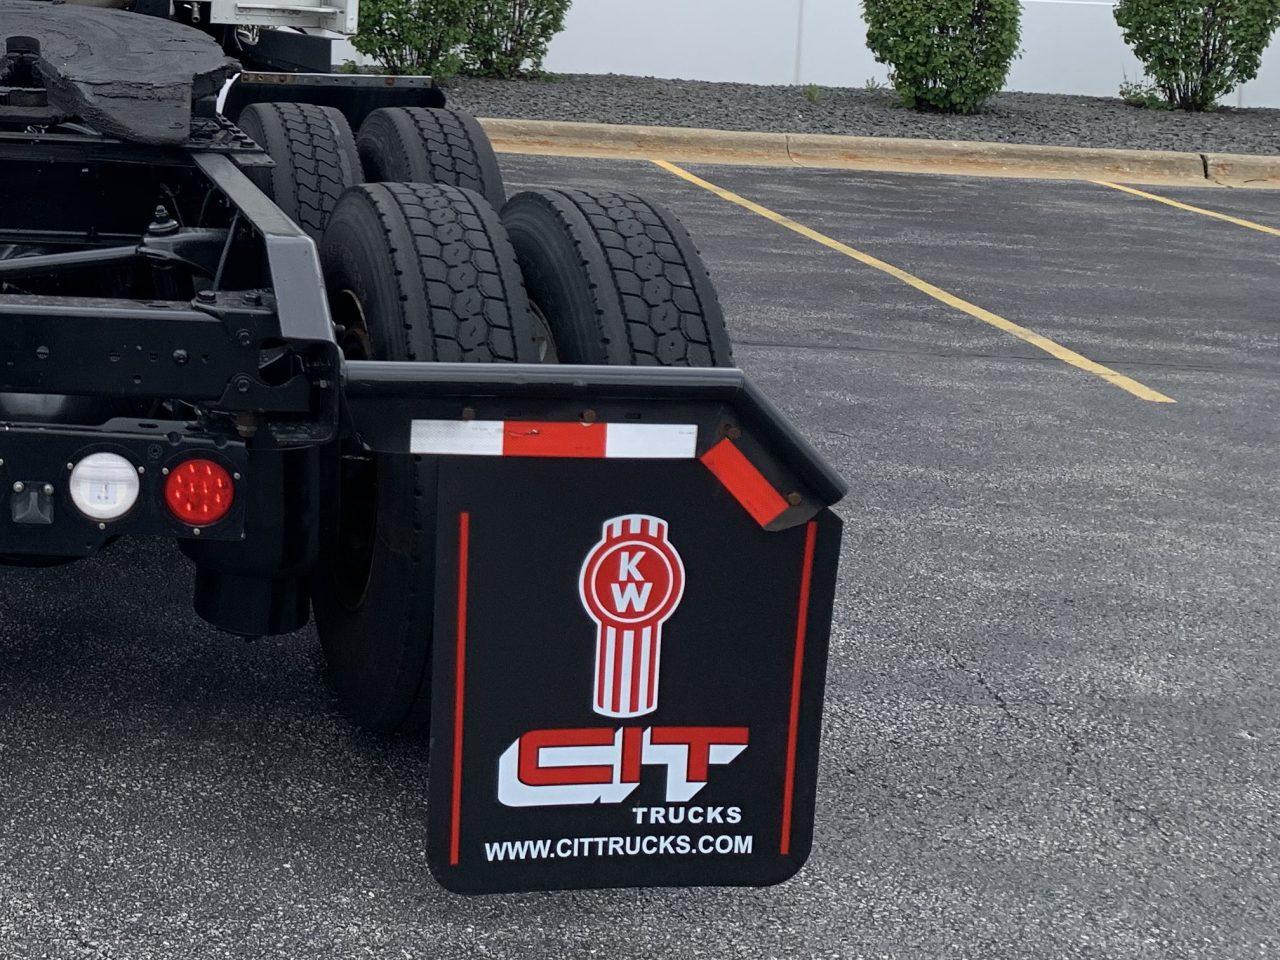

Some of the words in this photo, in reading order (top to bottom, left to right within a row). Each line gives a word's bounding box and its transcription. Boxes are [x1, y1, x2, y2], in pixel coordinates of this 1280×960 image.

[497, 727, 749, 807] CIT
[632, 806, 742, 825] TRUCKS
[484, 834, 753, 862] WWW.CITTRUCKS.COM
